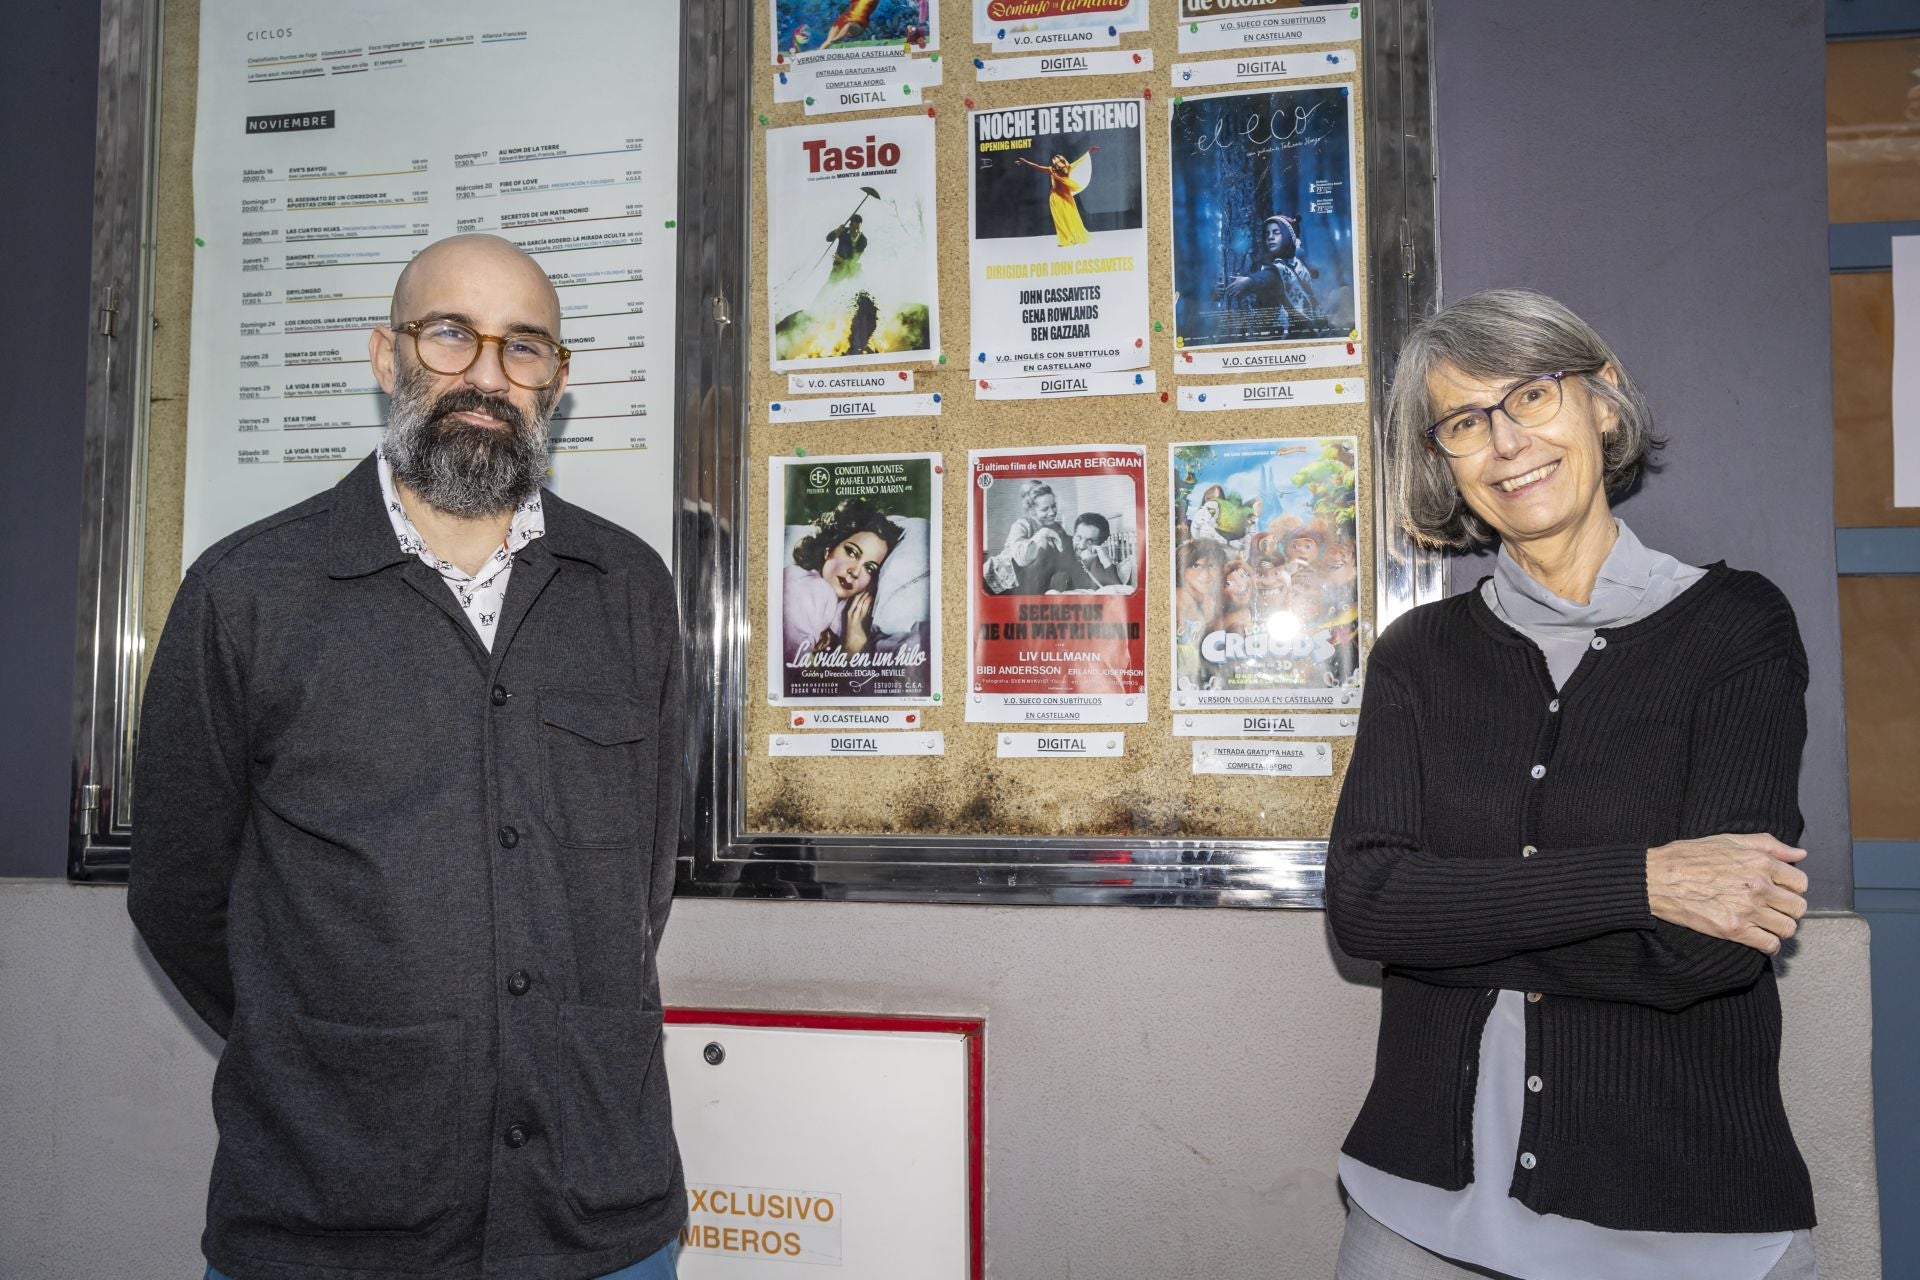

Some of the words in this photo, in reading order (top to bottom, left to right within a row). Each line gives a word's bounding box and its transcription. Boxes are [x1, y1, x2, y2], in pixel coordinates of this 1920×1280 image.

[1220, 23, 1235, 31] V.O.
[1236, 21, 1261, 29] SUECO
[247, 28, 292, 41] CICLOS
[1014, 37, 1033, 45] V.O.
[1035, 32, 1093, 44] CASTELLANO
[1255, 31, 1303, 40] CASTELLANO
[827, 52, 859, 60] DOBLADA
[861, 50, 906, 59] CASTELLANO
[1041, 57, 1088, 70] DIGITAL
[1237, 61, 1287, 74] DIGITAL
[816, 69, 844, 77] ENTRADA
[845, 67, 875, 75] GRATUITA
[826, 80, 862, 88] COMPLETAR
[840, 92, 886, 105] DIGITAL
[249, 115, 328, 131] NOVIEMBRE
[979, 110, 1036, 141] NOCHE
[1038, 107, 1060, 135] DE
[1063, 102, 1138, 133] ESTRENO
[1197, 118, 1234, 151] el
[1238, 102, 1326, 145] eco
[979, 141, 1010, 153] OPENING
[1011, 138, 1032, 151] NIGHT
[802, 135, 901, 173] Tasio
[836, 170, 860, 179] MONTXO
[861, 168, 897, 177] ARMENDÁRIZ
[501, 213, 530, 221] SECRETOS
[549, 207, 589, 216] MATRIMONIO
[527, 238, 548, 246] GARCÍA
[986, 264, 1029, 280] DIRIGIDA
[1030, 262, 1049, 277] POR
[1051, 261, 1073, 276] JOHN
[1075, 256, 1134, 274] CASSAVETES
[1019, 290, 1043, 305] JOHN
[1044, 285, 1101, 303] CASSAVETES
[1022, 309, 1046, 324] GENA
[1047, 305, 1099, 322] ROWLANDS
[1031, 326, 1049, 342] BEN
[1050, 323, 1090, 340] GAZZARA
[1014, 352, 1044, 361] INGLÉS
[1067, 349, 1120, 358] SUBTITULOS
[1222, 357, 1242, 366] V.O.
[1245, 354, 1306, 365] CASTELLANO
[1023, 364, 1035, 372] EN
[1037, 362, 1092, 371] CASTELLANO
[808, 380, 828, 388] V.O.
[829, 378, 885, 387] CASTELLANO
[1041, 379, 1088, 391] DIGITAL
[1243, 386, 1294, 399] DIGITAL
[830, 403, 876, 414] DIGITAL
[834, 465, 870, 476] CONCHITA
[871, 464, 904, 474] MONTES
[985, 462, 1010, 471] último
[1010, 462, 1026, 470] film
[1027, 462, 1037, 470] de
[1038, 459, 1082, 469] INGMAR
[1084, 457, 1142, 468] BERGMAN
[840, 476, 865, 486] RAFAEL
[867, 474, 896, 485] DURAN
[835, 484, 879, 496] GUILLERMO
[880, 484, 904, 494] MARIN
[1019, 604, 1103, 621] SECRETOS
[1003, 623, 1027, 640] UN
[786, 641, 812, 669] La
[813, 645, 848, 668] vida
[850, 653, 871, 668] en
[872, 652, 894, 667] un
[891, 643, 927, 668] hilo
[1019, 652, 1038, 662] LIV
[1040, 652, 1101, 662] ULLMANN
[802, 670, 819, 678] Guión
[854, 670, 876, 678] EDGAR
[976, 665, 997, 675] BIBI
[999, 665, 1061, 675] ANDERSSON
[813, 715, 889, 724] V.O.CASTELLANO
[1243, 718, 1295, 729] DIGITAL
[831, 739, 878, 750] DIGITAL
[1038, 738, 1087, 749] DIGITAL
[1227, 762, 1267, 770] COMPLETA
[690, 1189, 834, 1222] XCLUSIVO
[680, 1225, 801, 1256] MBEROS
